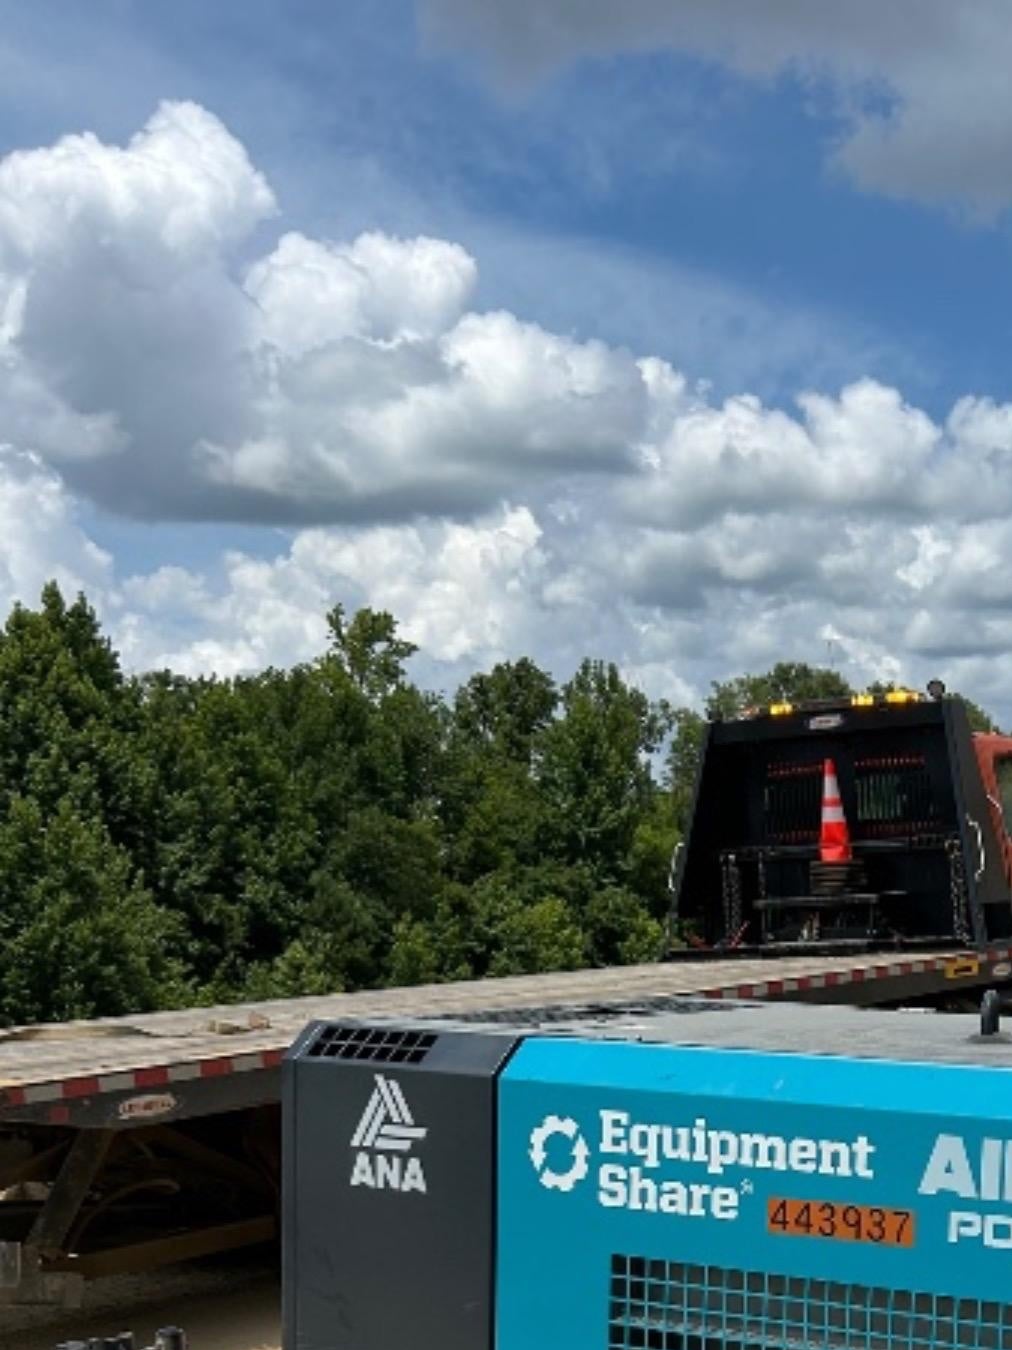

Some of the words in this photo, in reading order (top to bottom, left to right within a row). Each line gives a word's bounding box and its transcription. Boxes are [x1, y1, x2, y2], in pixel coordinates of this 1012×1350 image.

[598, 1109, 876, 1180] Equipment
[350, 1153, 427, 1194] ANA
[769, 1199, 911, 1244] 443937
